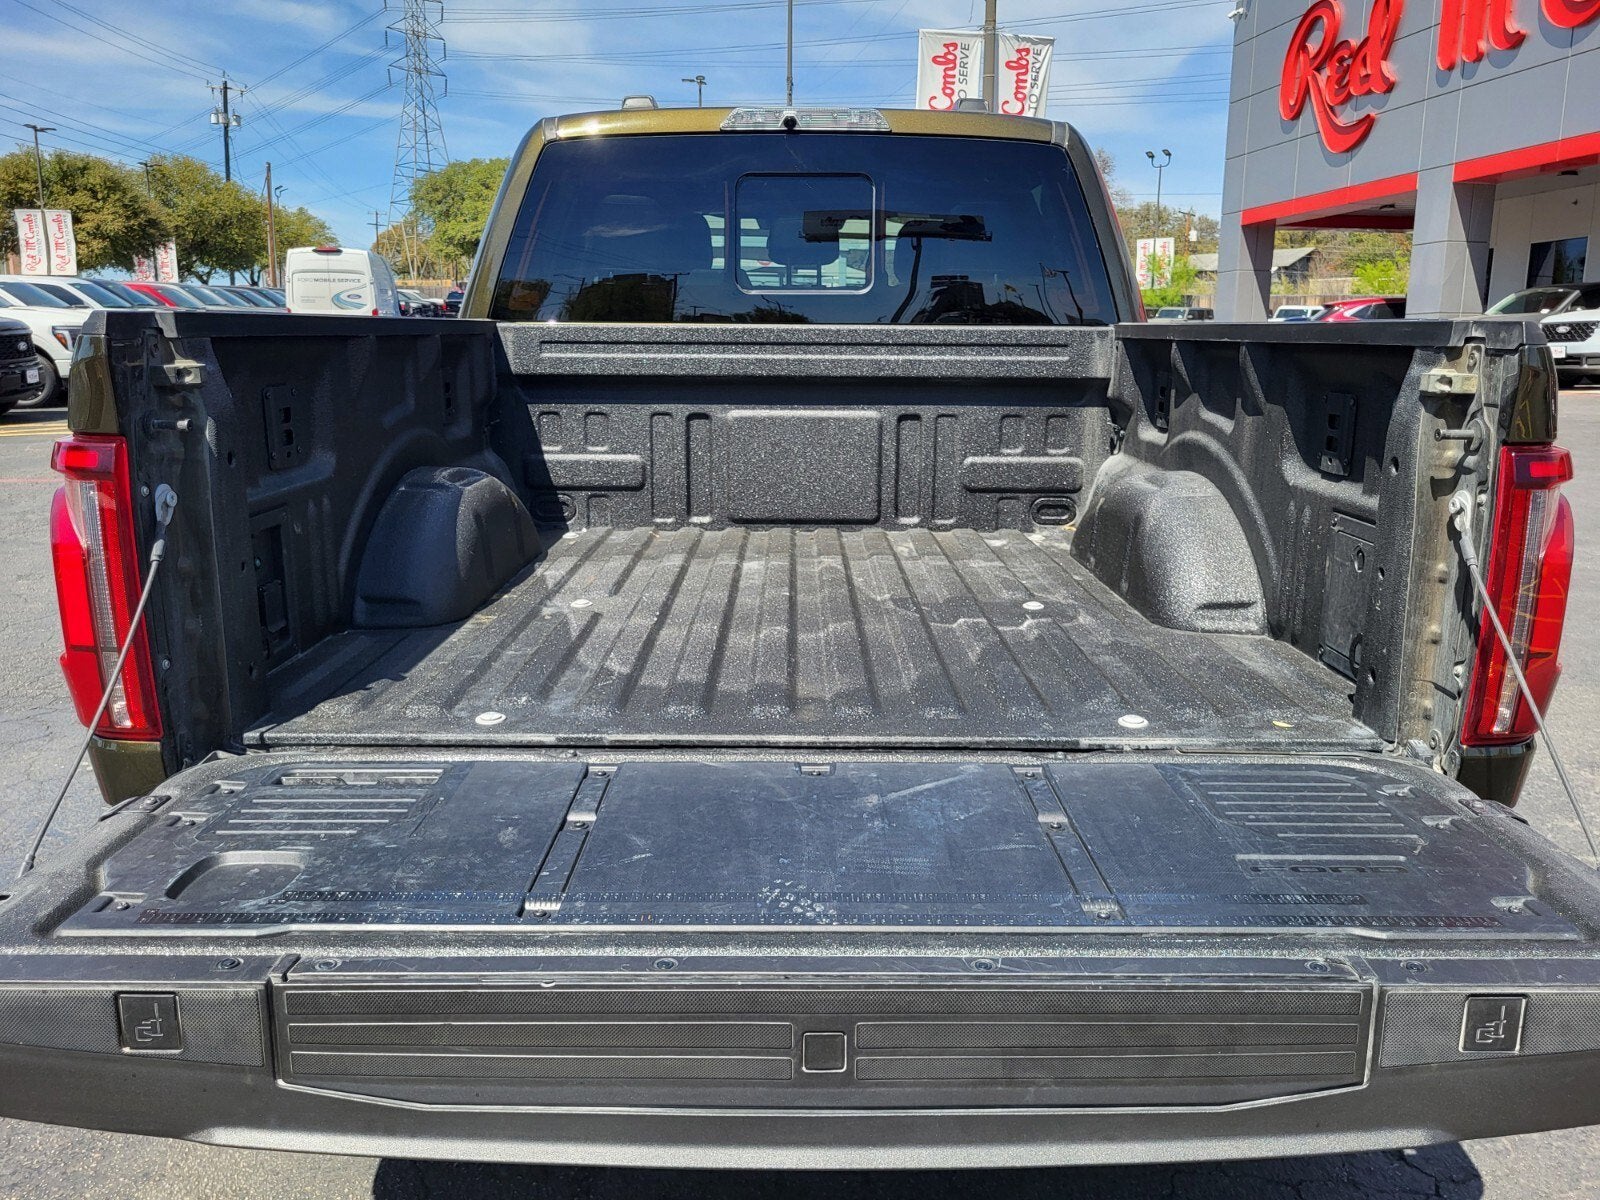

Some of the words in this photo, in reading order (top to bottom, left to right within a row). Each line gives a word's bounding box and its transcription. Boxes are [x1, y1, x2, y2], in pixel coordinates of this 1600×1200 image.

[928, 42, 958, 110] Combs
[958, 42, 970, 85] SERVE
[1001, 47, 1030, 116] Combs
[1030, 47, 1042, 89] SERVE
[1279, 0, 1402, 154] Red
[1027, 93, 1040, 117] TO
[25, 254, 41, 271] Red
[55, 254, 70, 271] Red
